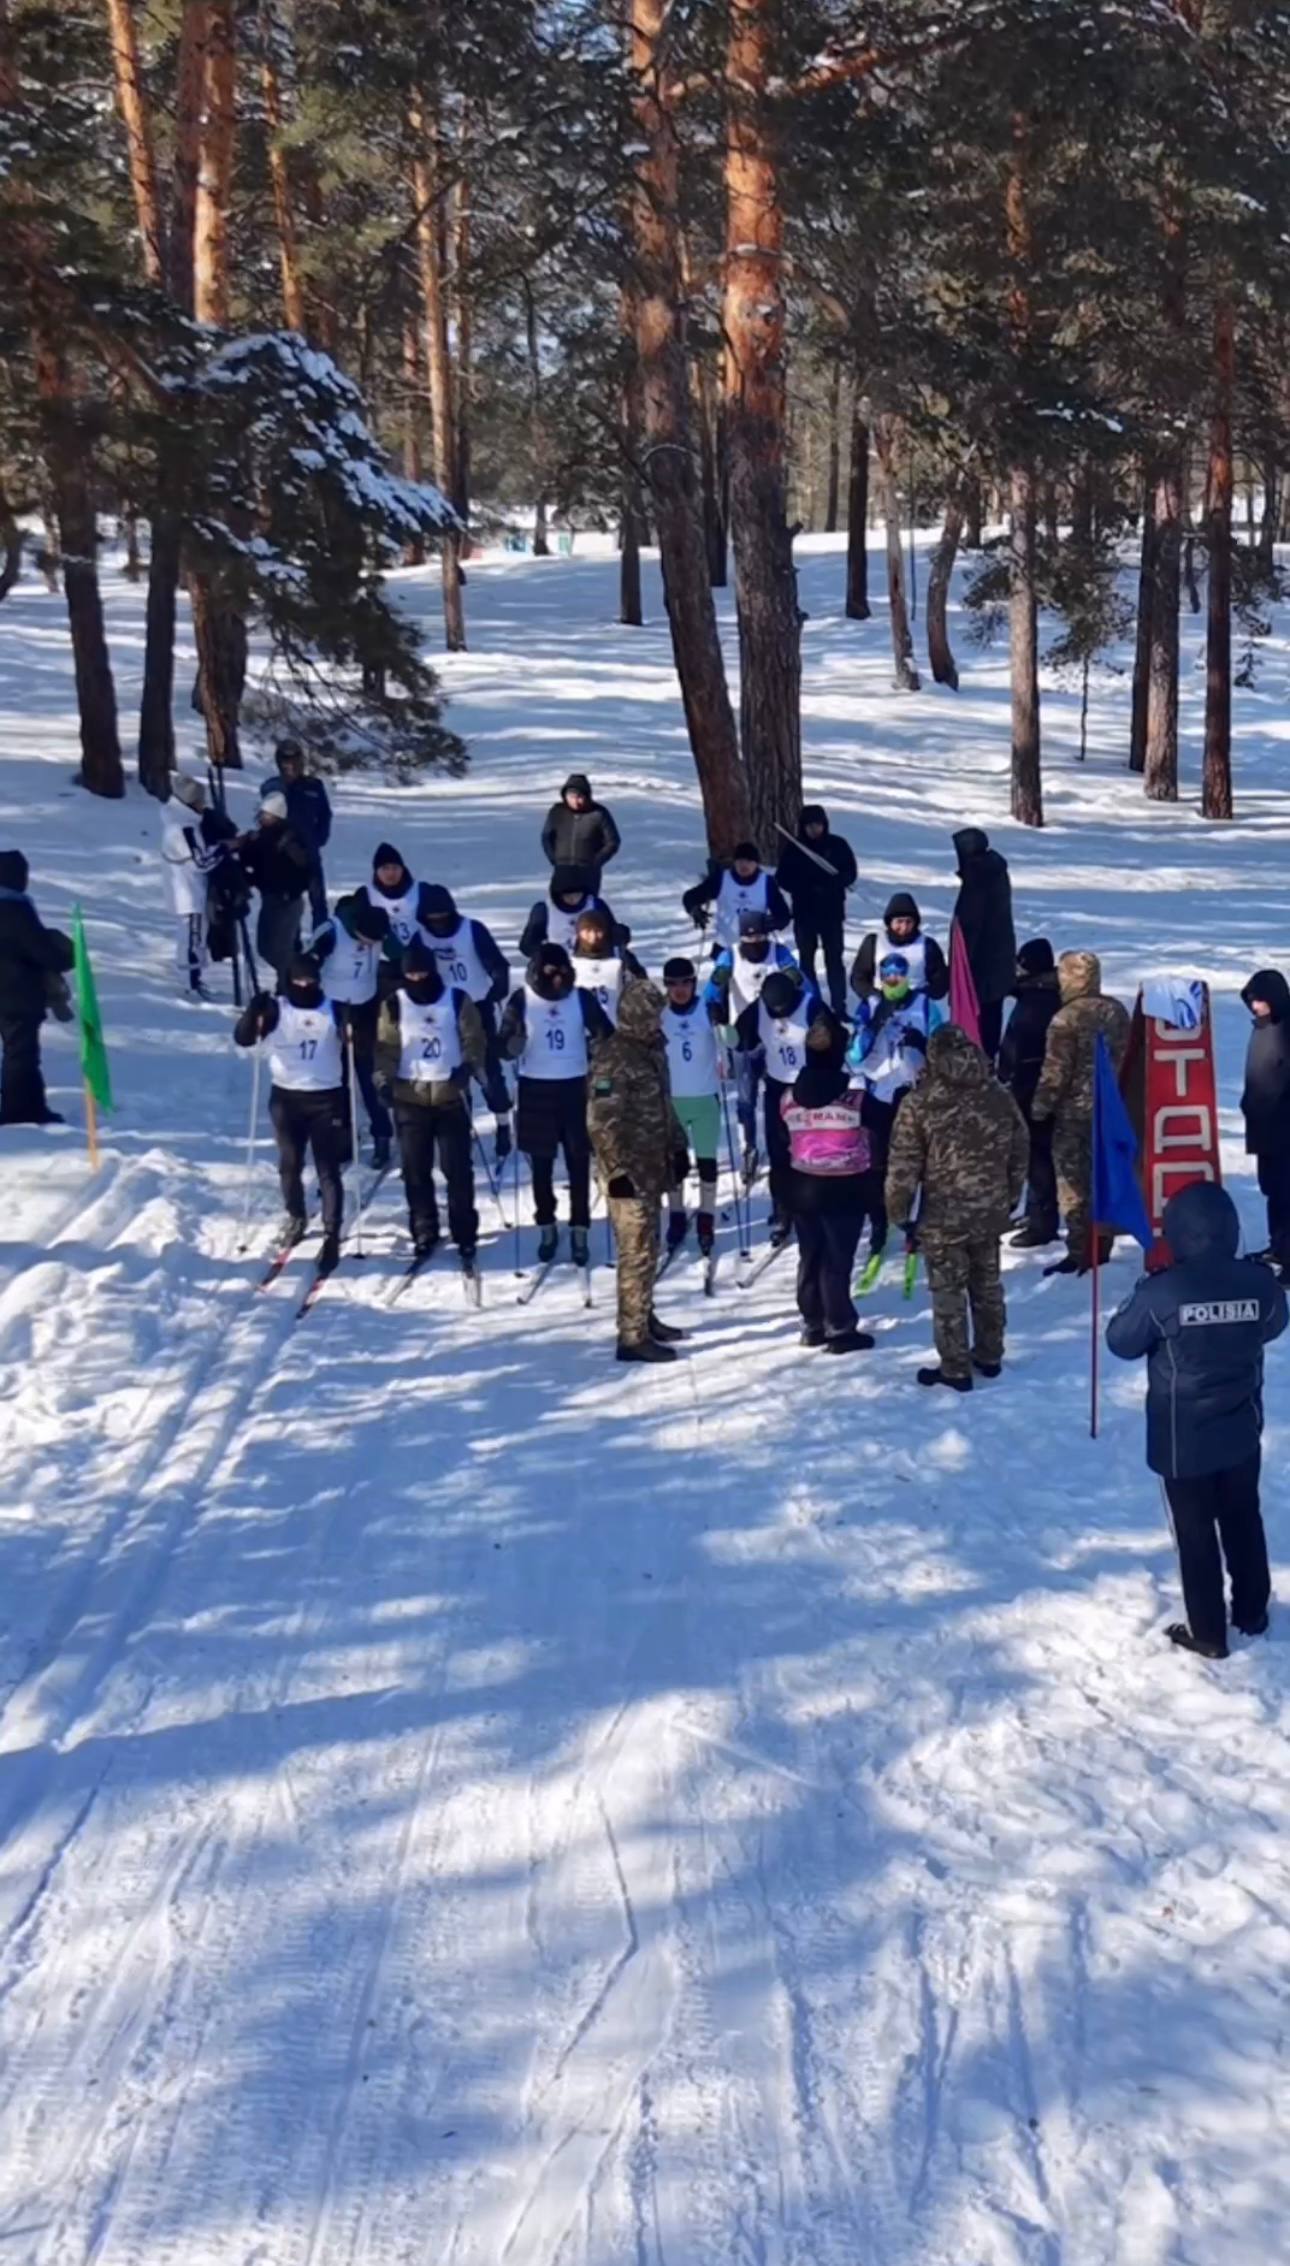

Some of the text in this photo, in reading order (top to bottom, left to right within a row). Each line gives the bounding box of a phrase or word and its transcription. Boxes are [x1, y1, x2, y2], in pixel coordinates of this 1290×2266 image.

[353, 961, 363, 980] 7
[448, 962, 467, 981] 10
[421, 1037, 442, 1059] 20
[545, 1028, 565, 1050] 19
[299, 1039, 318, 1061] 17
[681, 1041, 692, 1062] 6
[779, 1045, 797, 1066] 18
[1182, 1302, 1257, 1323] POLISIA
